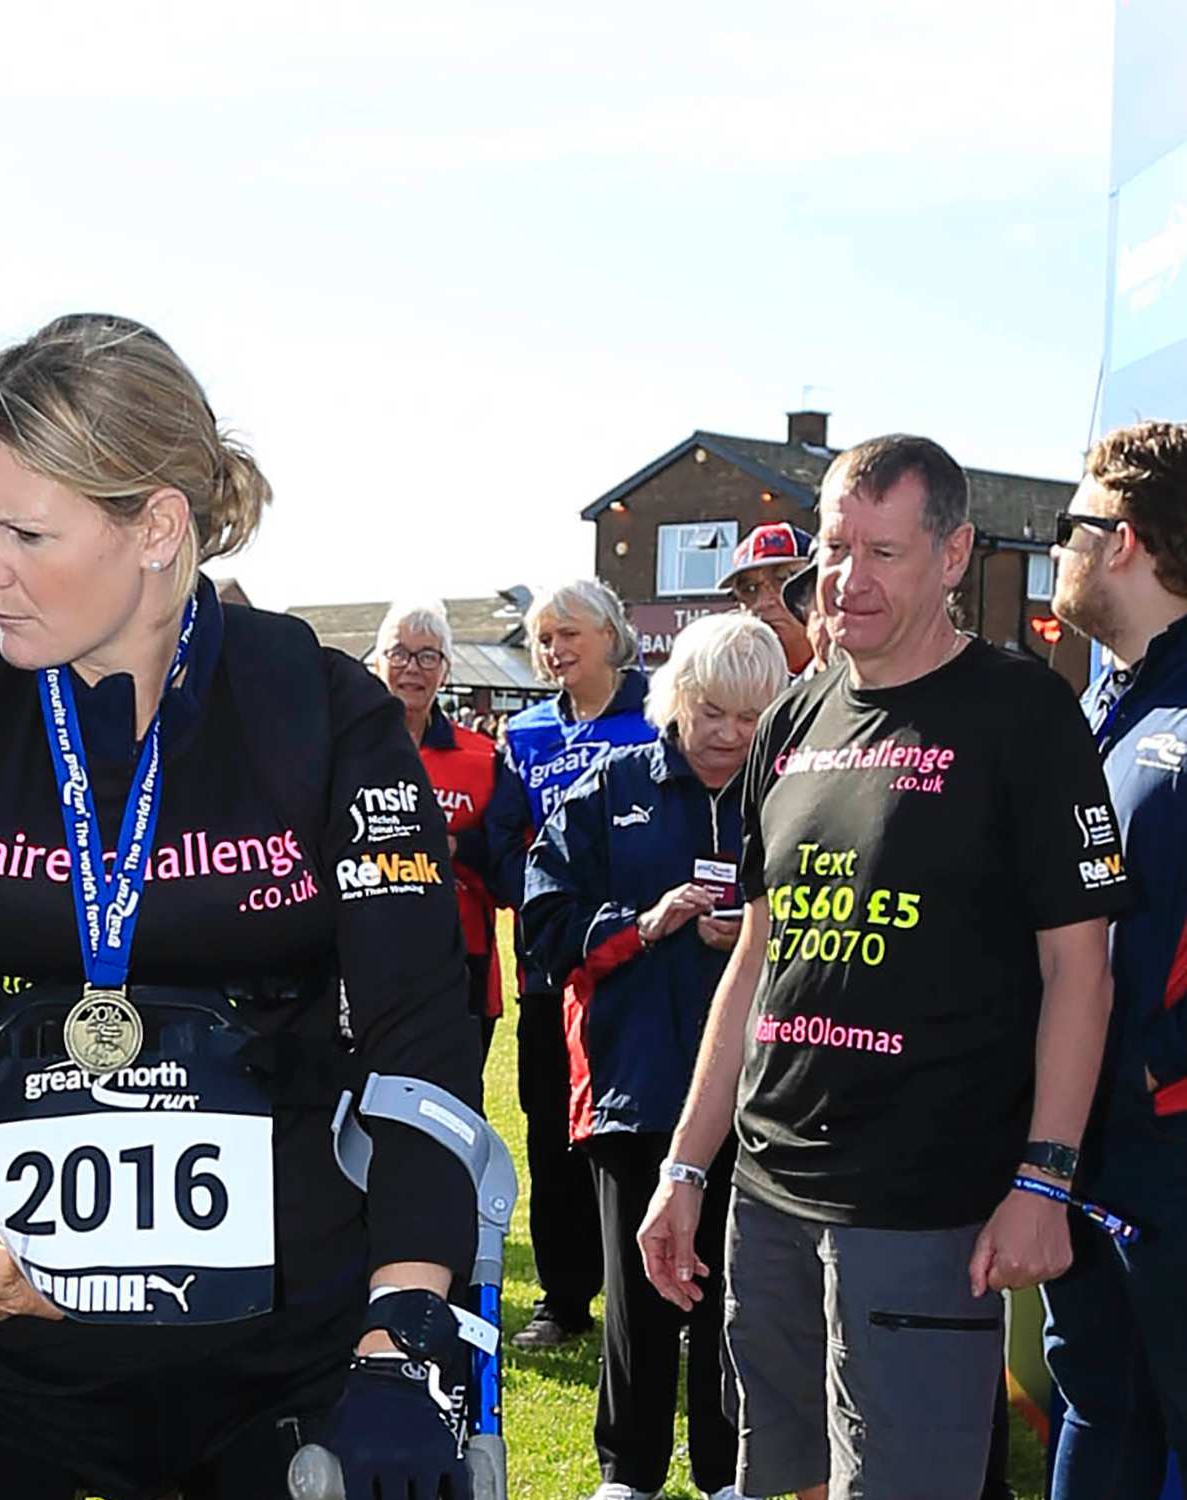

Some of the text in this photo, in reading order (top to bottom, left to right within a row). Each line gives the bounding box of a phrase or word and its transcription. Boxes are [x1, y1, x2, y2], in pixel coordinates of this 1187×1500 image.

[57, 728, 71, 752] run
[529, 748, 590, 788] great
[889, 774, 944, 793] .co.uk
[364, 781, 419, 812] nsif
[433, 788, 474, 813] un
[75, 821, 89, 847] The
[124, 843, 141, 870] The
[336, 853, 443, 891] ReWalk
[798, 844, 857, 877] Text
[238, 870, 318, 912] .co.uk
[867, 889, 921, 928] £5
[784, 928, 885, 966] 70070
[86, 1006, 122, 1022] 2016
[25, 1061, 187, 1100] great north
[149, 1093, 197, 1110] run
[5, 1143, 229, 1236] 2016
